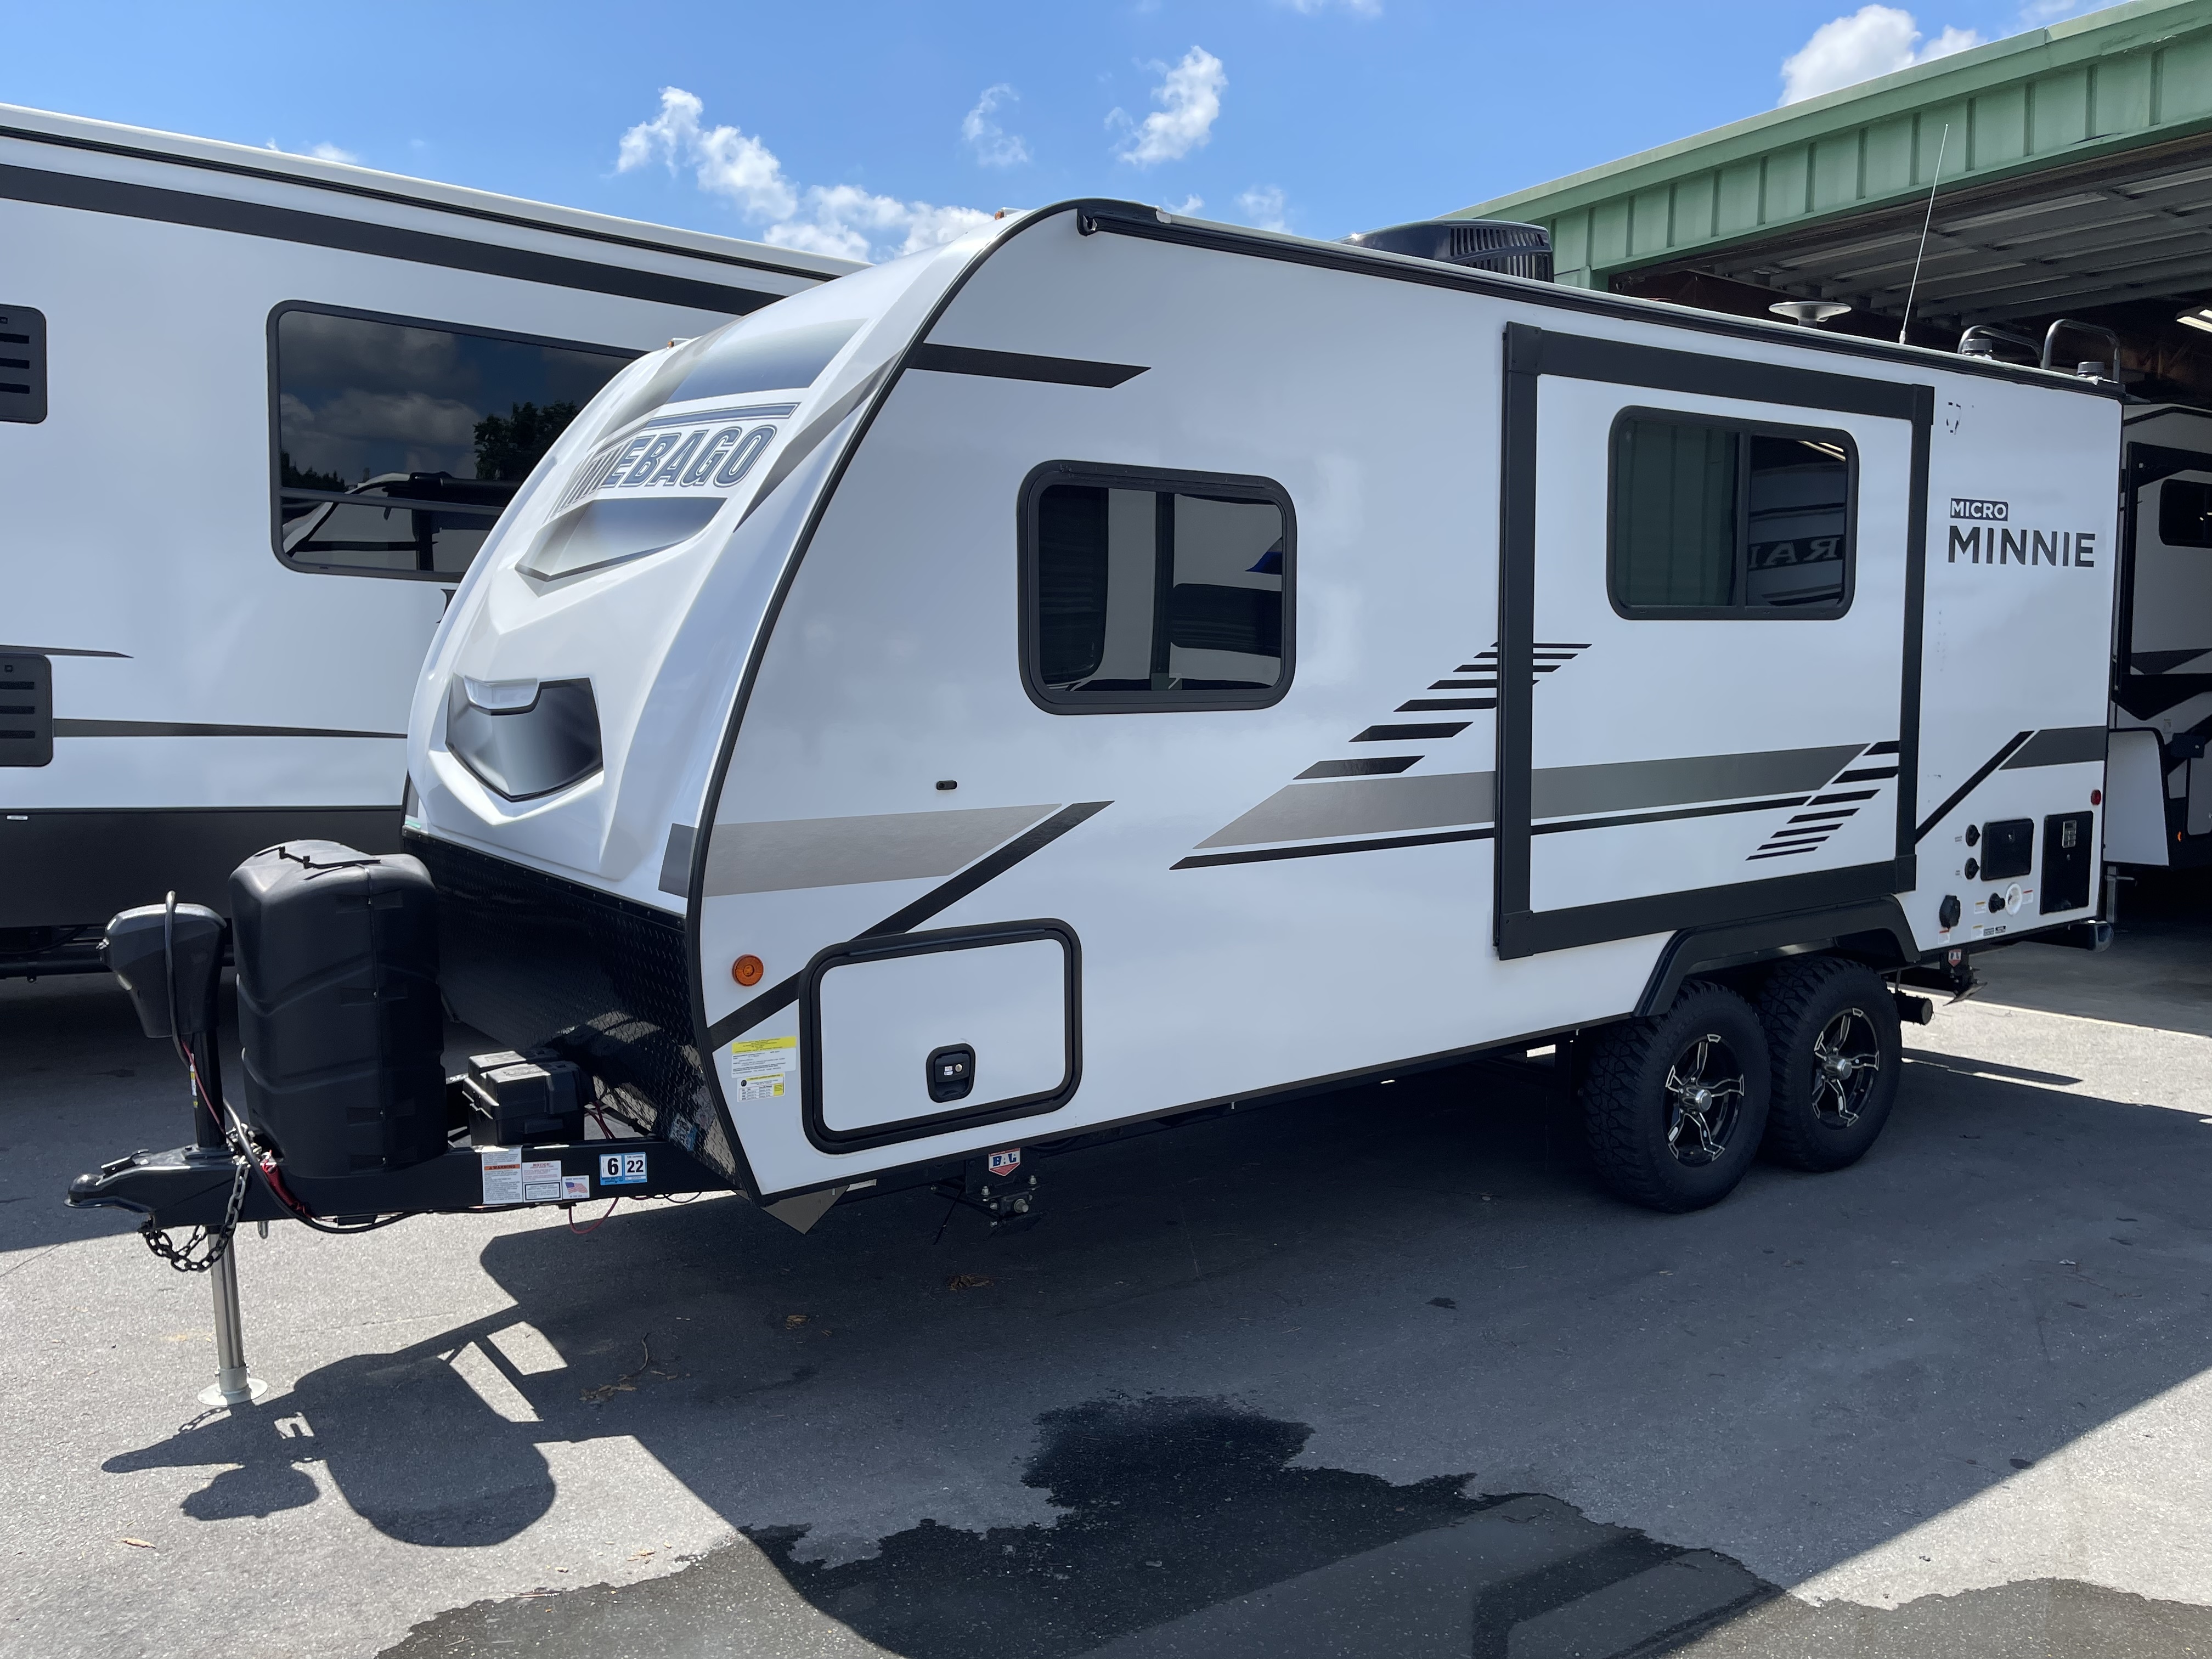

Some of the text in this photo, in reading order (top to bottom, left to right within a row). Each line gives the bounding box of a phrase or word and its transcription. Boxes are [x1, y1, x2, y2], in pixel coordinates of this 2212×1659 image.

[1950, 500, 2007, 520] MICRO
[1948, 526, 2095, 567] MINNIE
[607, 1158, 644, 1176] 6 22
